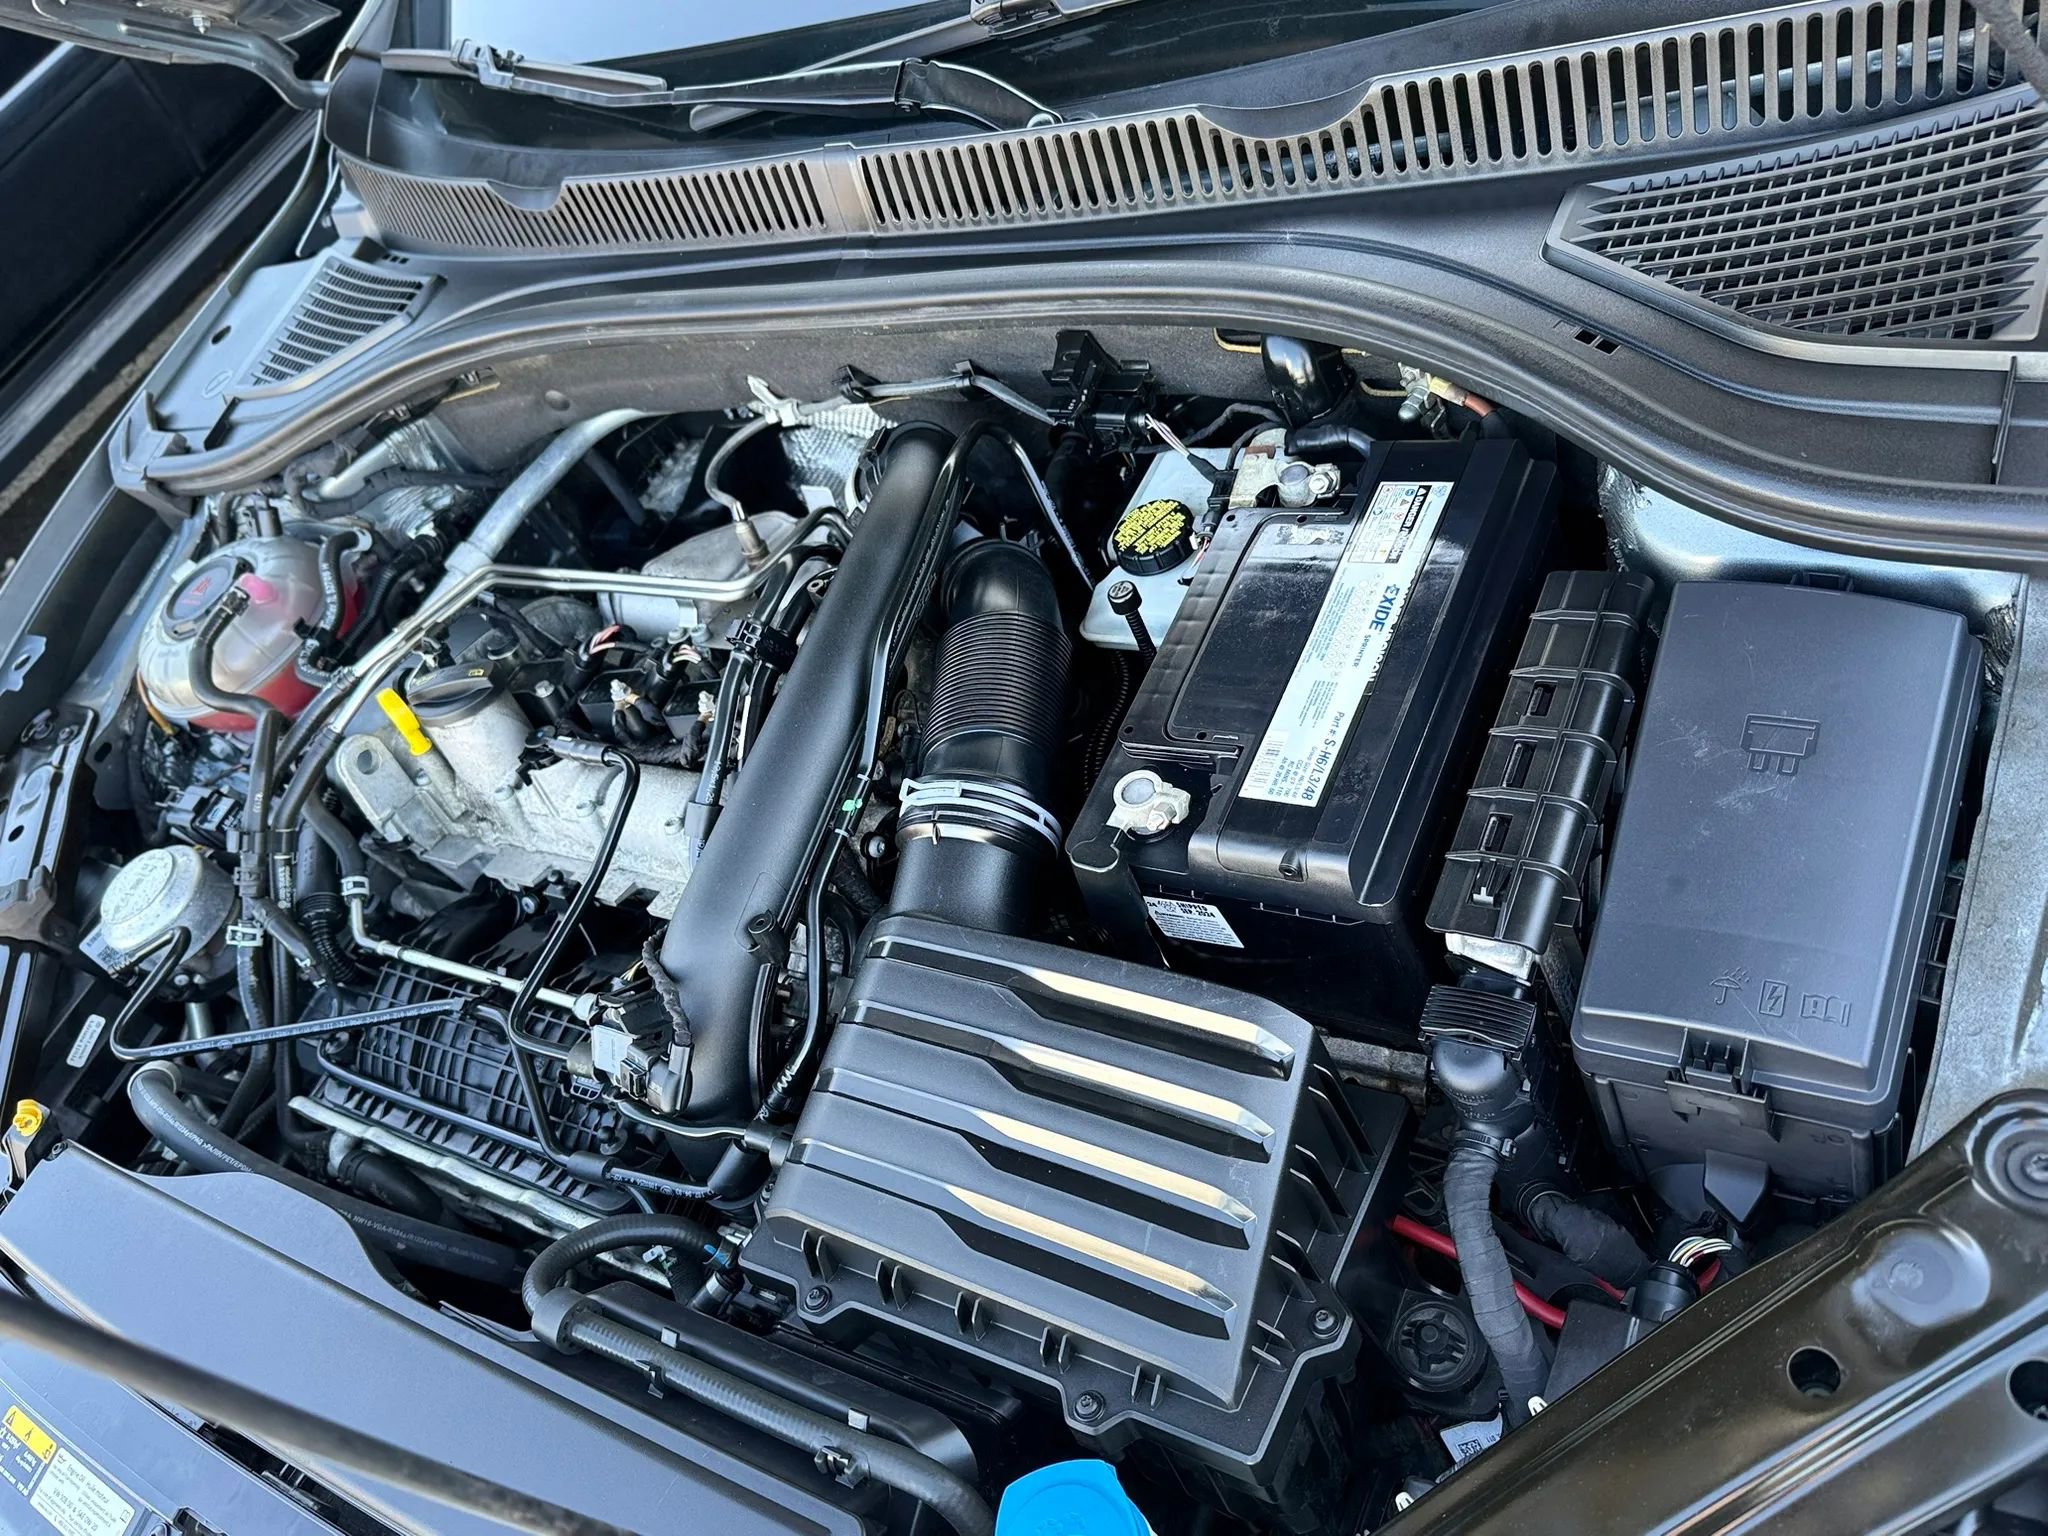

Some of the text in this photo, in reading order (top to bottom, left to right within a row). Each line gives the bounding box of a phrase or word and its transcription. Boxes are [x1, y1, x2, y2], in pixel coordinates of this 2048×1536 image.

[1369, 583, 1400, 632] EXIDE
[1353, 634, 1371, 667] SPRINTER
[1333, 711, 1345, 727] Part
[1301, 738, 1336, 800] S-H6/L3/48
[1176, 902, 1208, 911] SHIPPED
[1197, 910, 1216, 918] 2024
